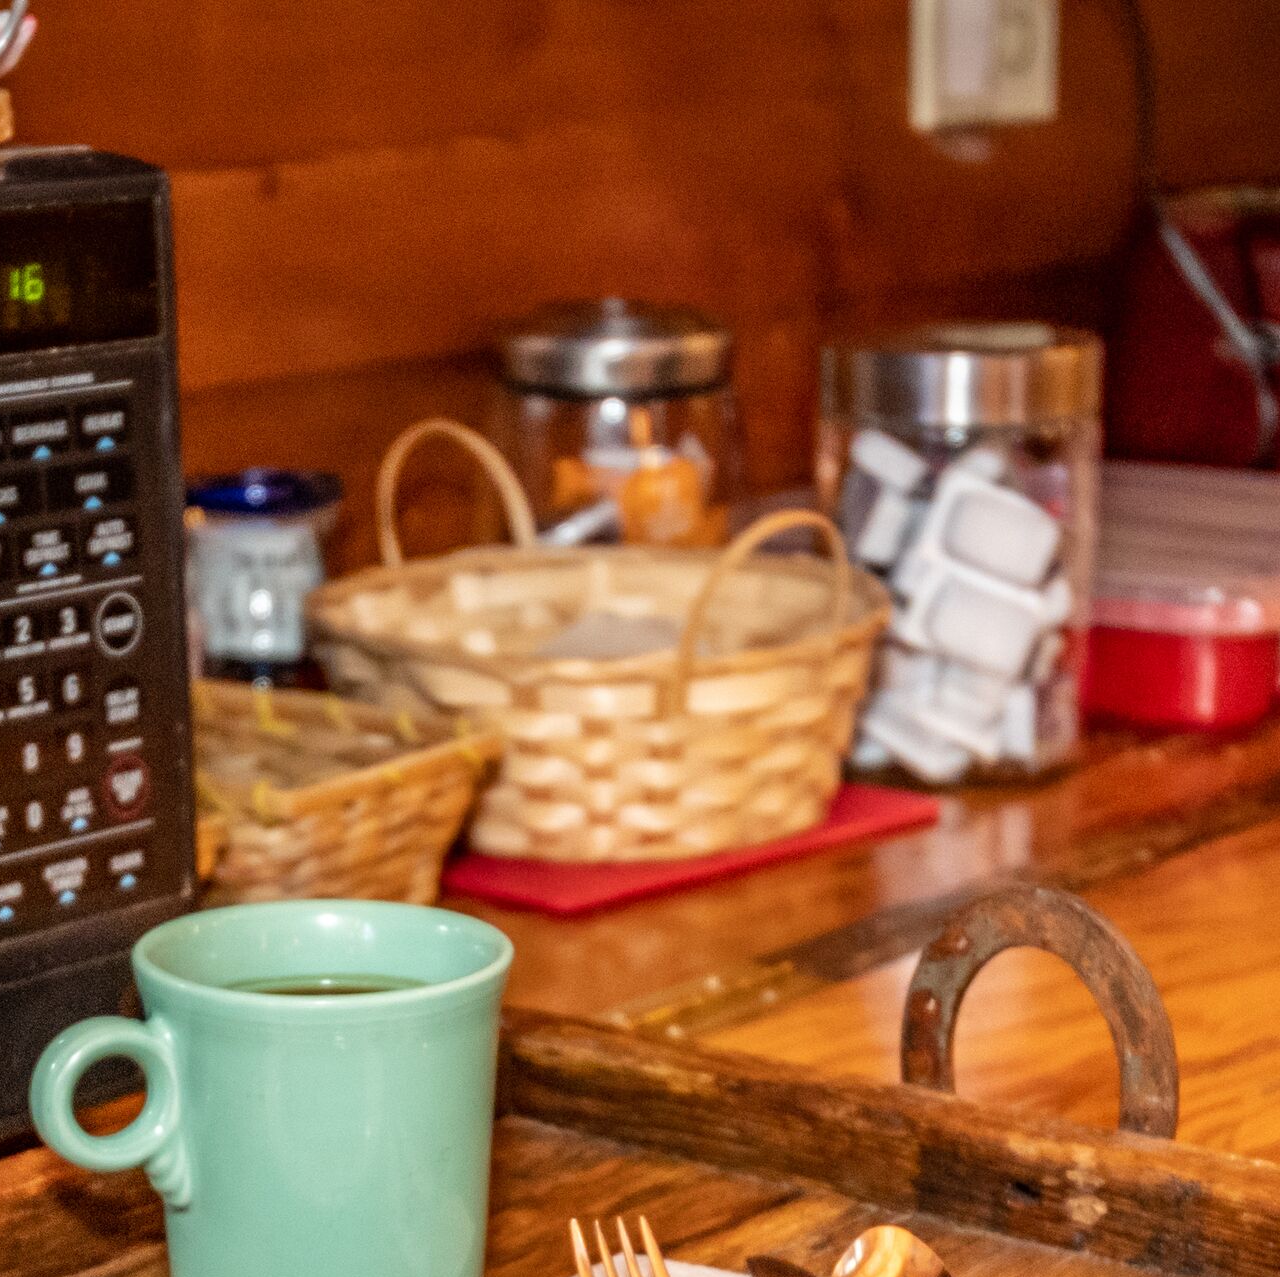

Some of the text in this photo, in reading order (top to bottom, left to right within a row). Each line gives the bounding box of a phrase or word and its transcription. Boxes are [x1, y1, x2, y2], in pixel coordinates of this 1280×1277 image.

[15, 616, 31, 643] 2
[60, 607, 77, 634] 3
[19, 676, 34, 703] 5
[64, 674, 79, 702] 6
[23, 743, 39, 771] 8
[67, 732, 83, 761] 9
[27, 801, 42, 829] 0
